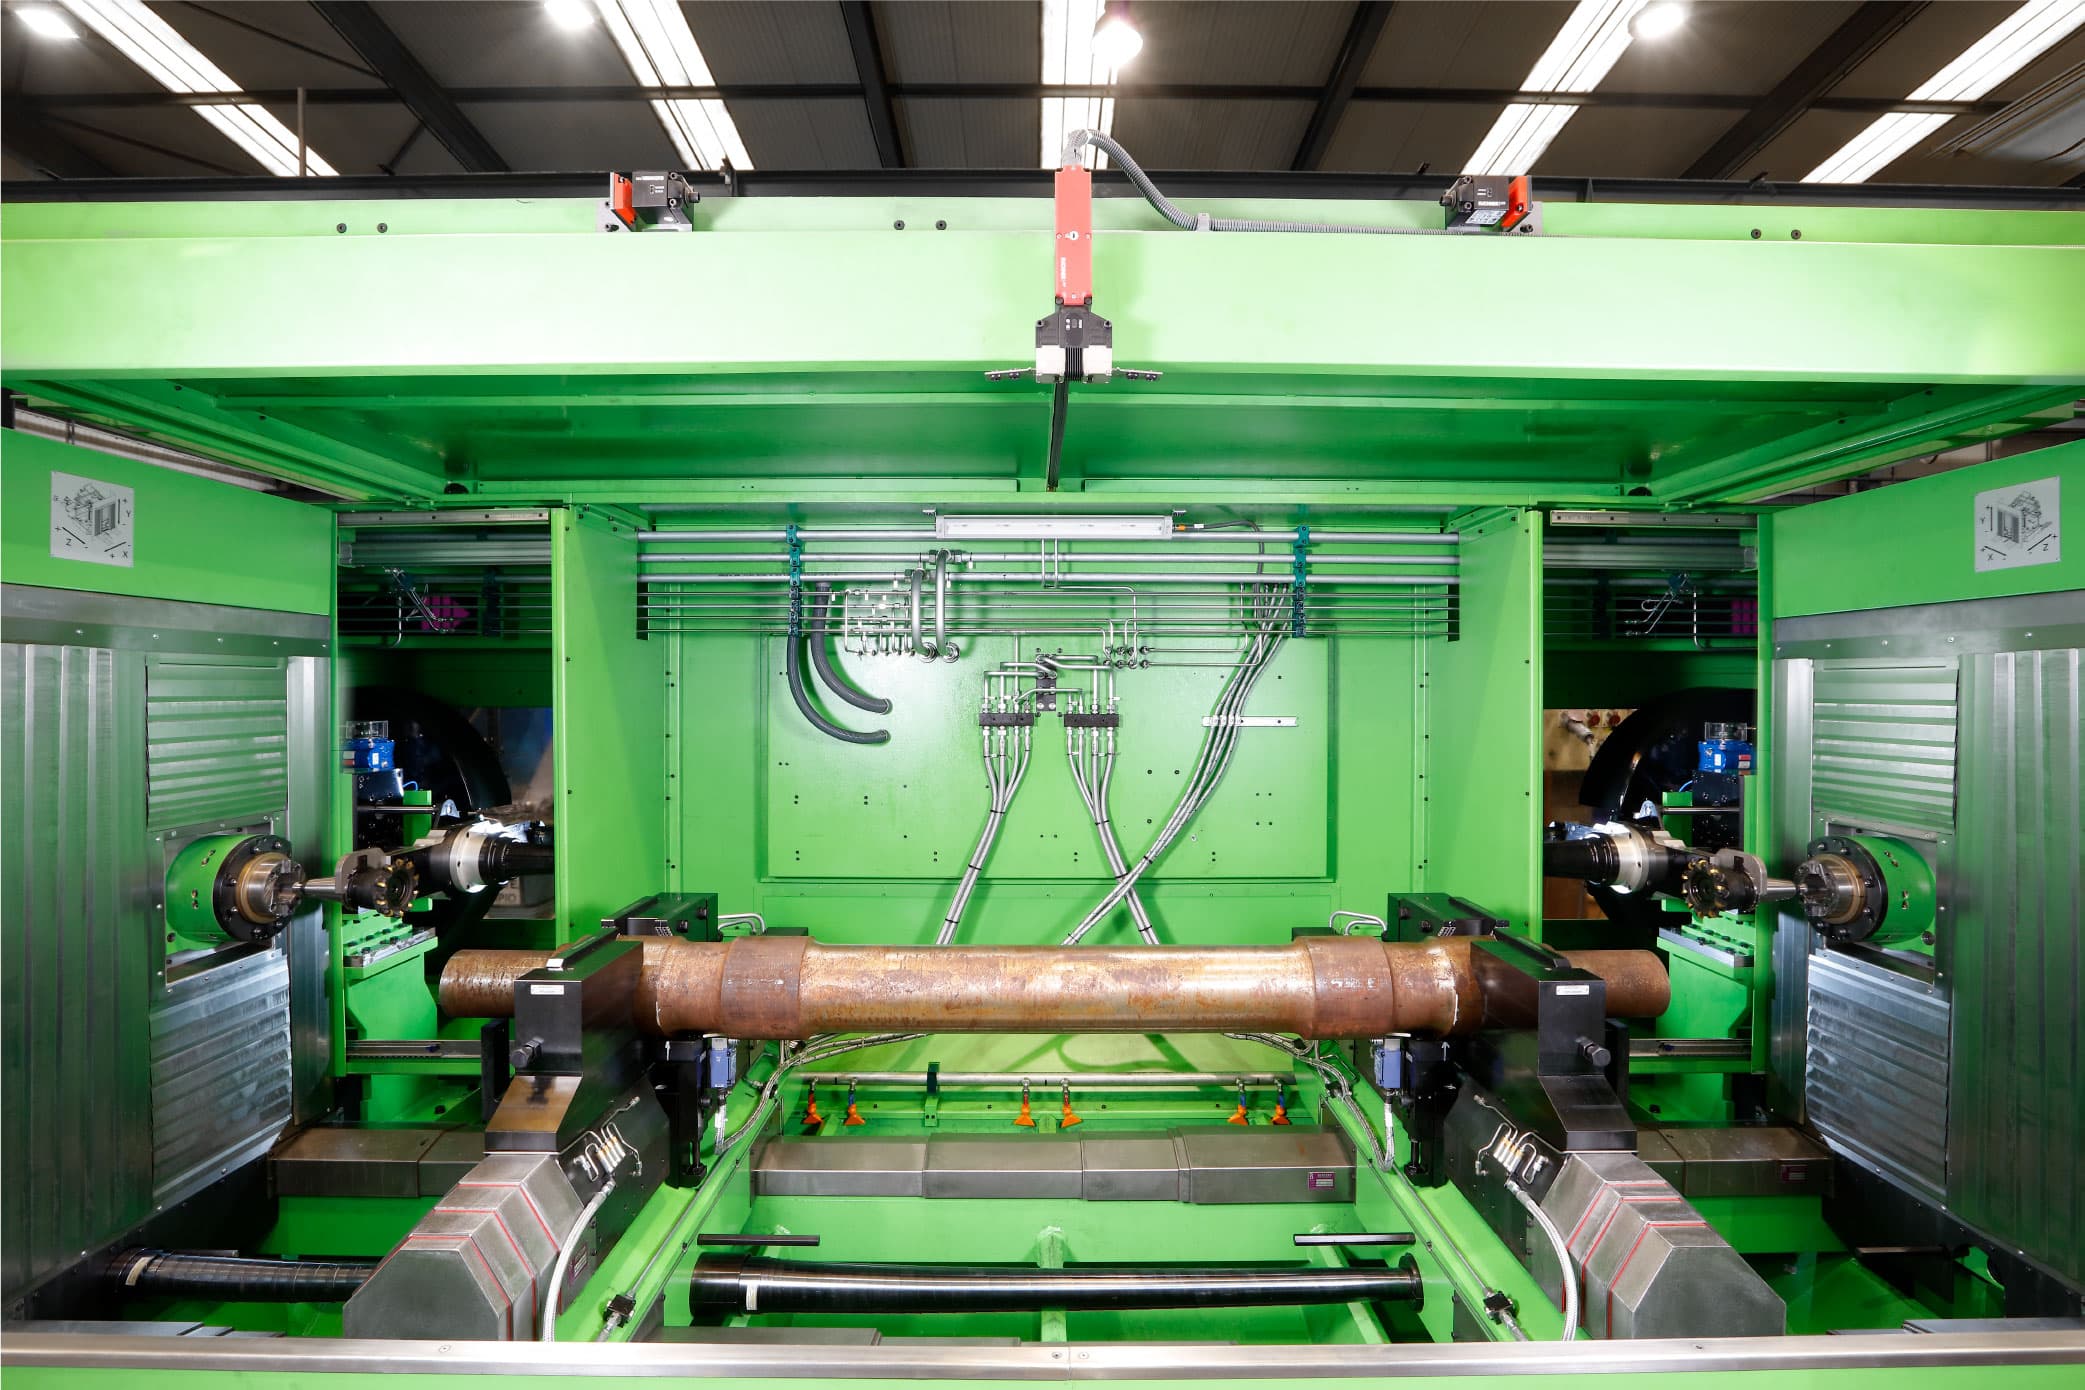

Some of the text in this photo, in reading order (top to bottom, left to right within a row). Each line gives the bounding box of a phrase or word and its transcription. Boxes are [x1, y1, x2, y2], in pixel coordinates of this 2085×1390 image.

[66, 538, 72, 546] Z
[2043, 543, 2048, 551] Z
[1987, 553, 1993, 561] X
